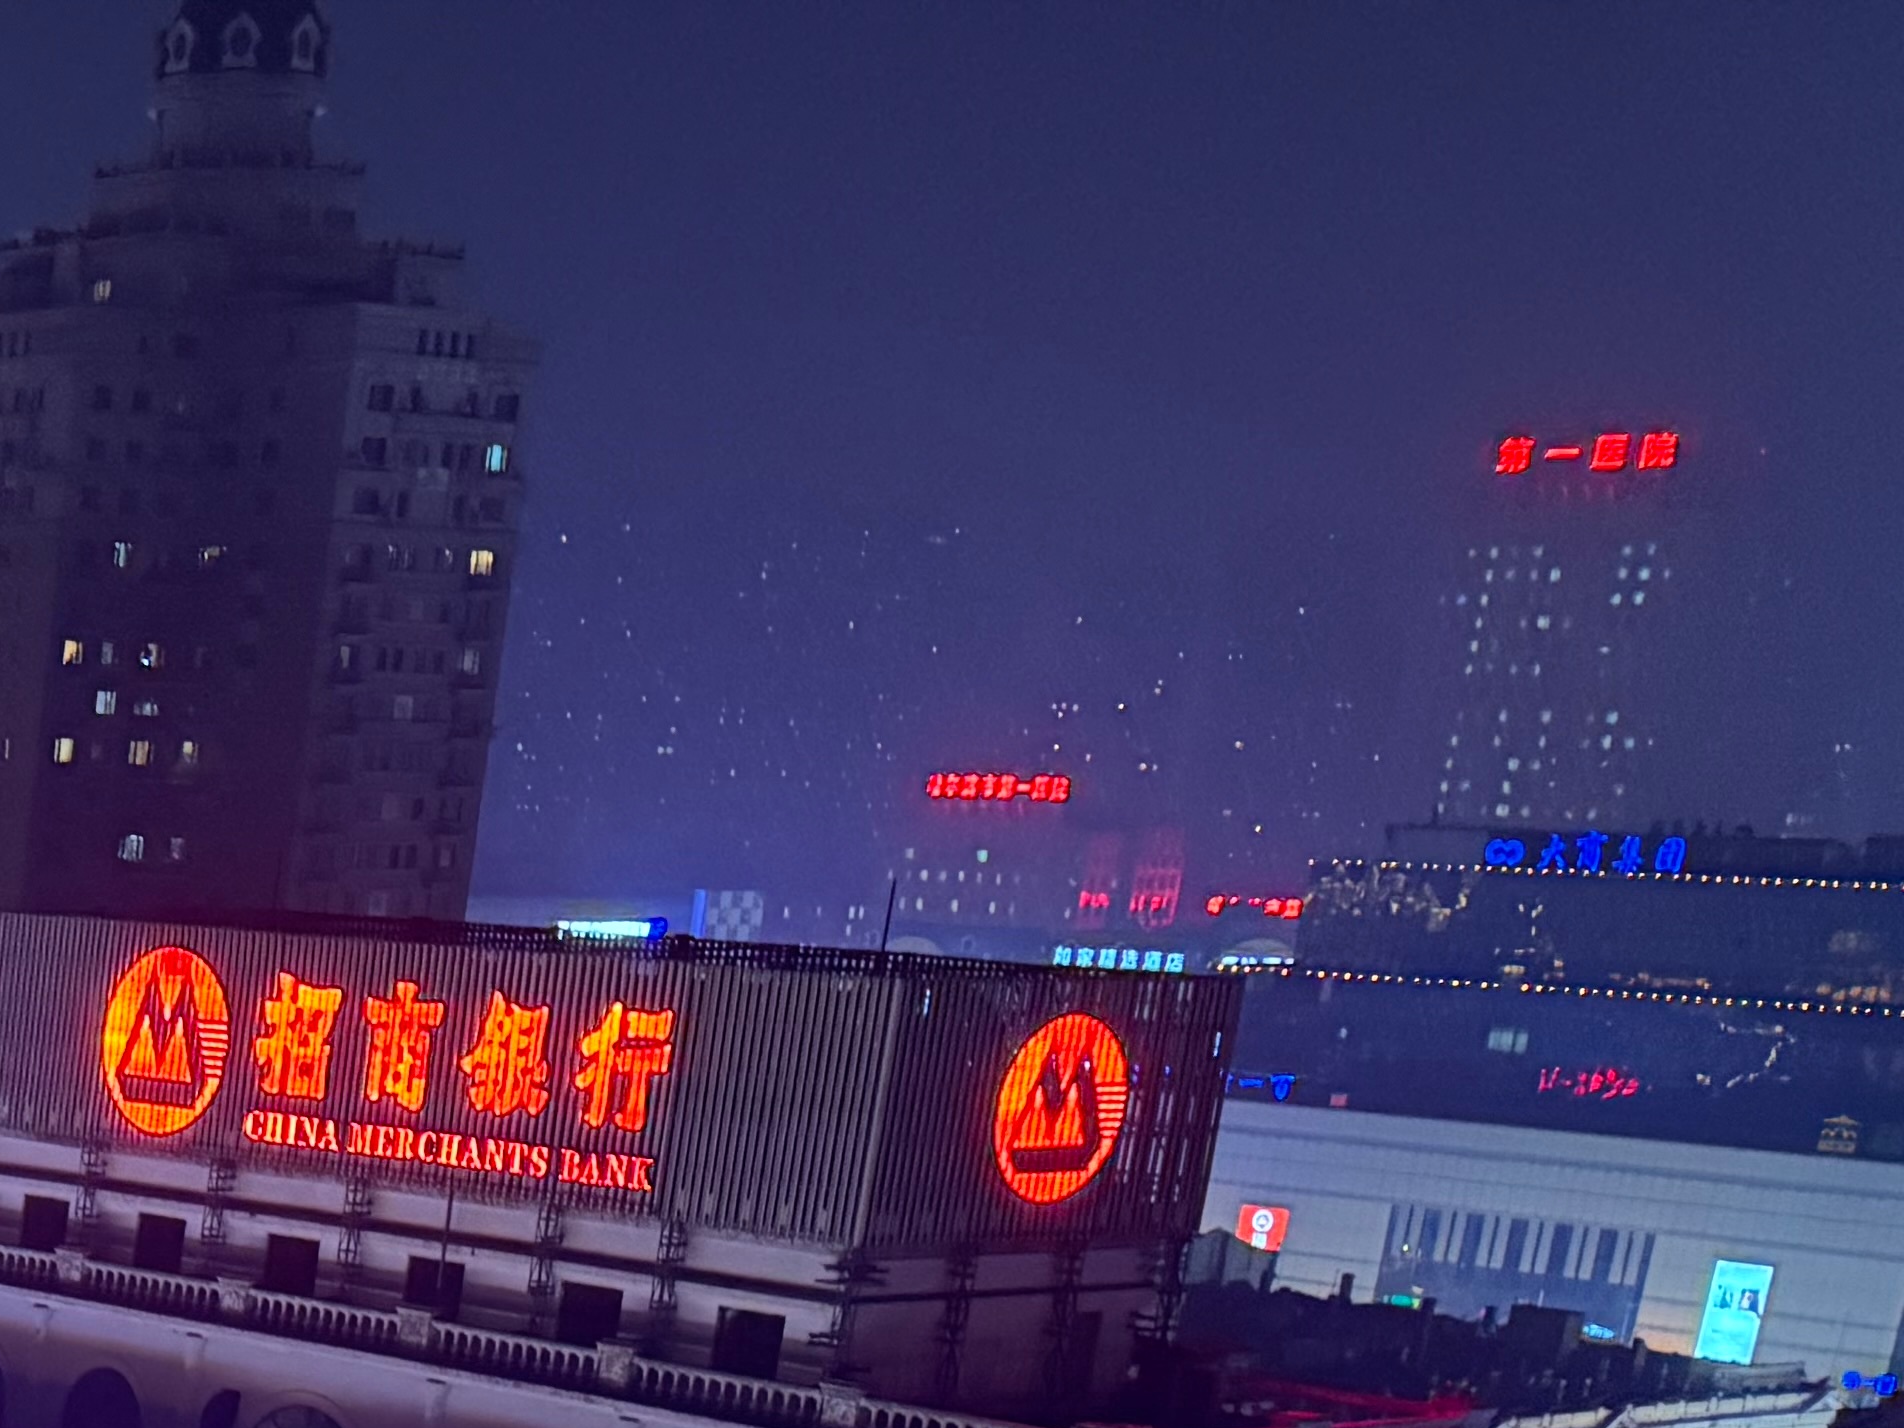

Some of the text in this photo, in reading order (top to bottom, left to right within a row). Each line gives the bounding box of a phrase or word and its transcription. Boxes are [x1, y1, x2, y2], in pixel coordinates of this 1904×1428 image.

[1495, 431, 1679, 474] 第一医院
[1053, 945, 1185, 974] 如家精选酒店
[254, 972, 677, 1133] 招商银行
[243, 1109, 655, 1193] CHINA MERCHANTS BANK
